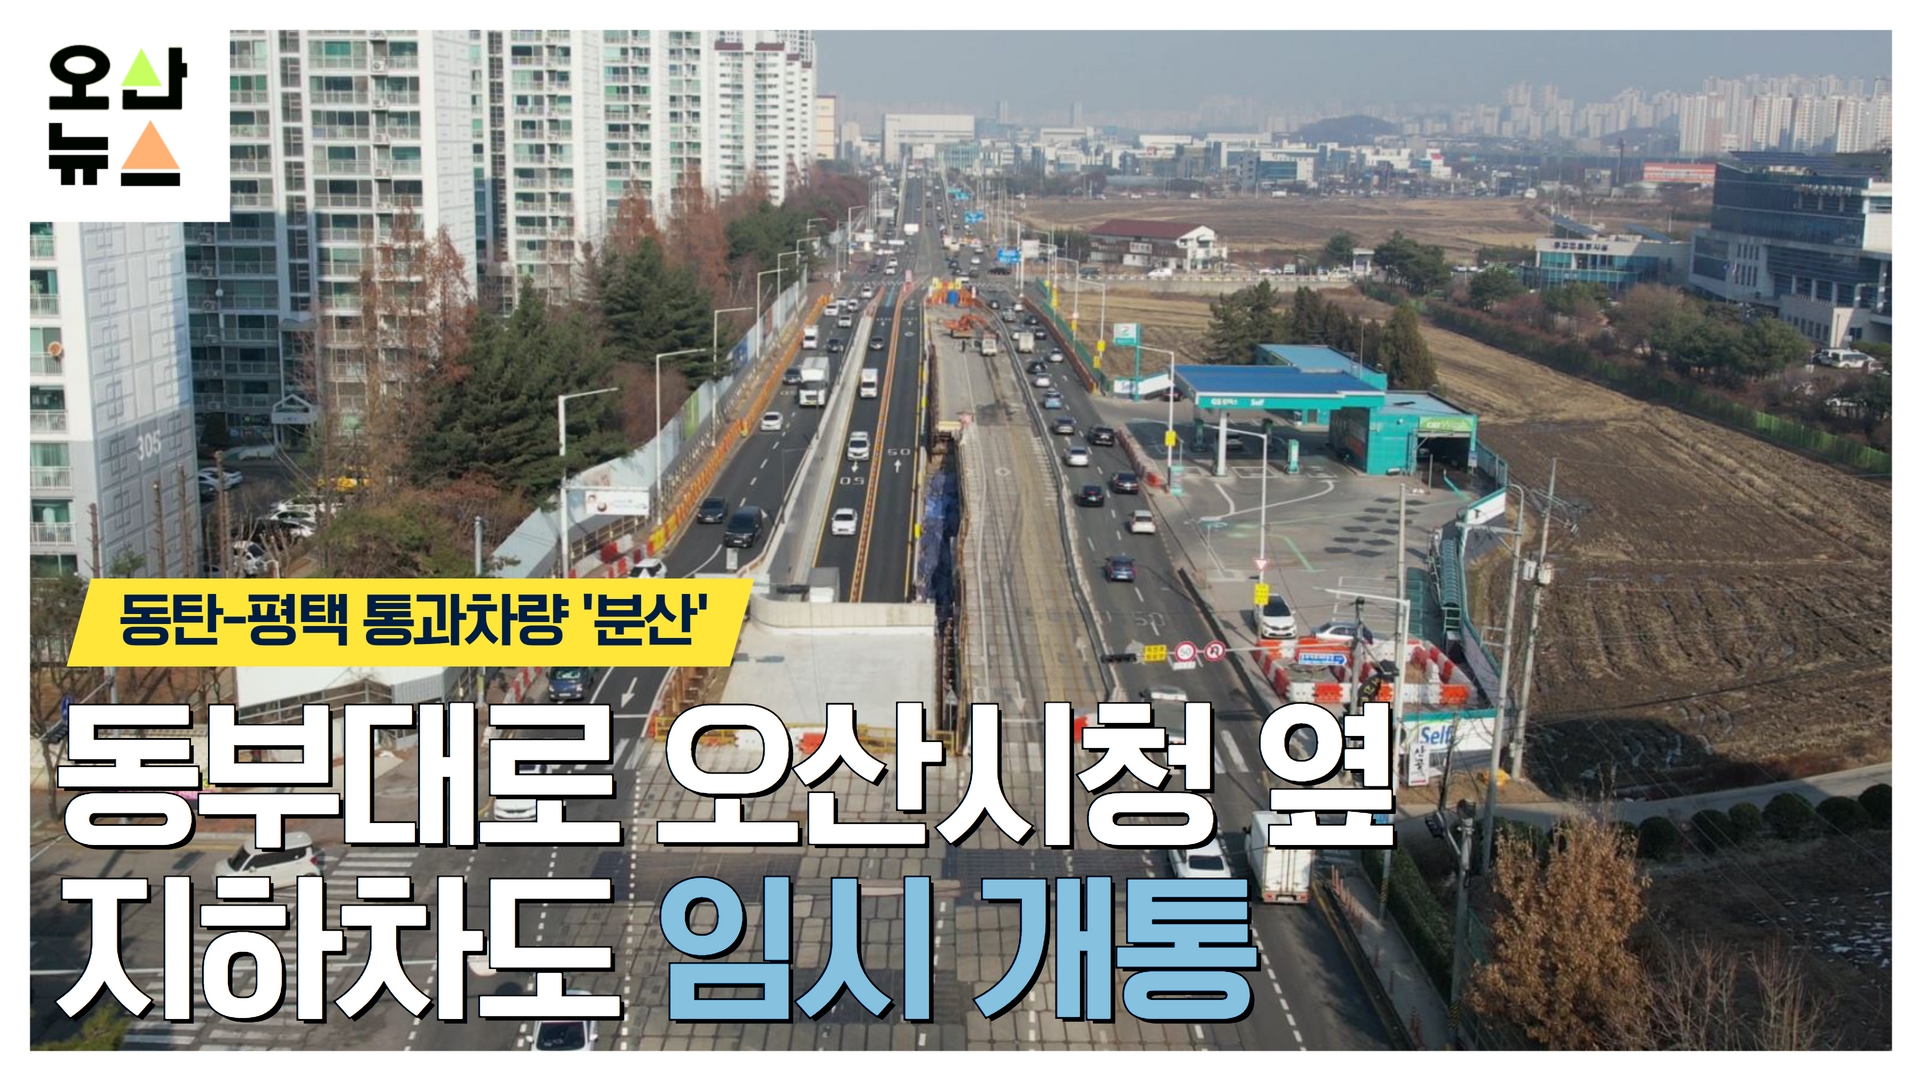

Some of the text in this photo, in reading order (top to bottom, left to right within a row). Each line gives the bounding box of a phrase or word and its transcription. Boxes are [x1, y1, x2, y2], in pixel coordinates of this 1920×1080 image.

[136, 429, 162, 461] 305
[887, 448, 911, 456] 50
[1180, 646, 1192, 656] 50
[1421, 725, 1453, 746] Self
